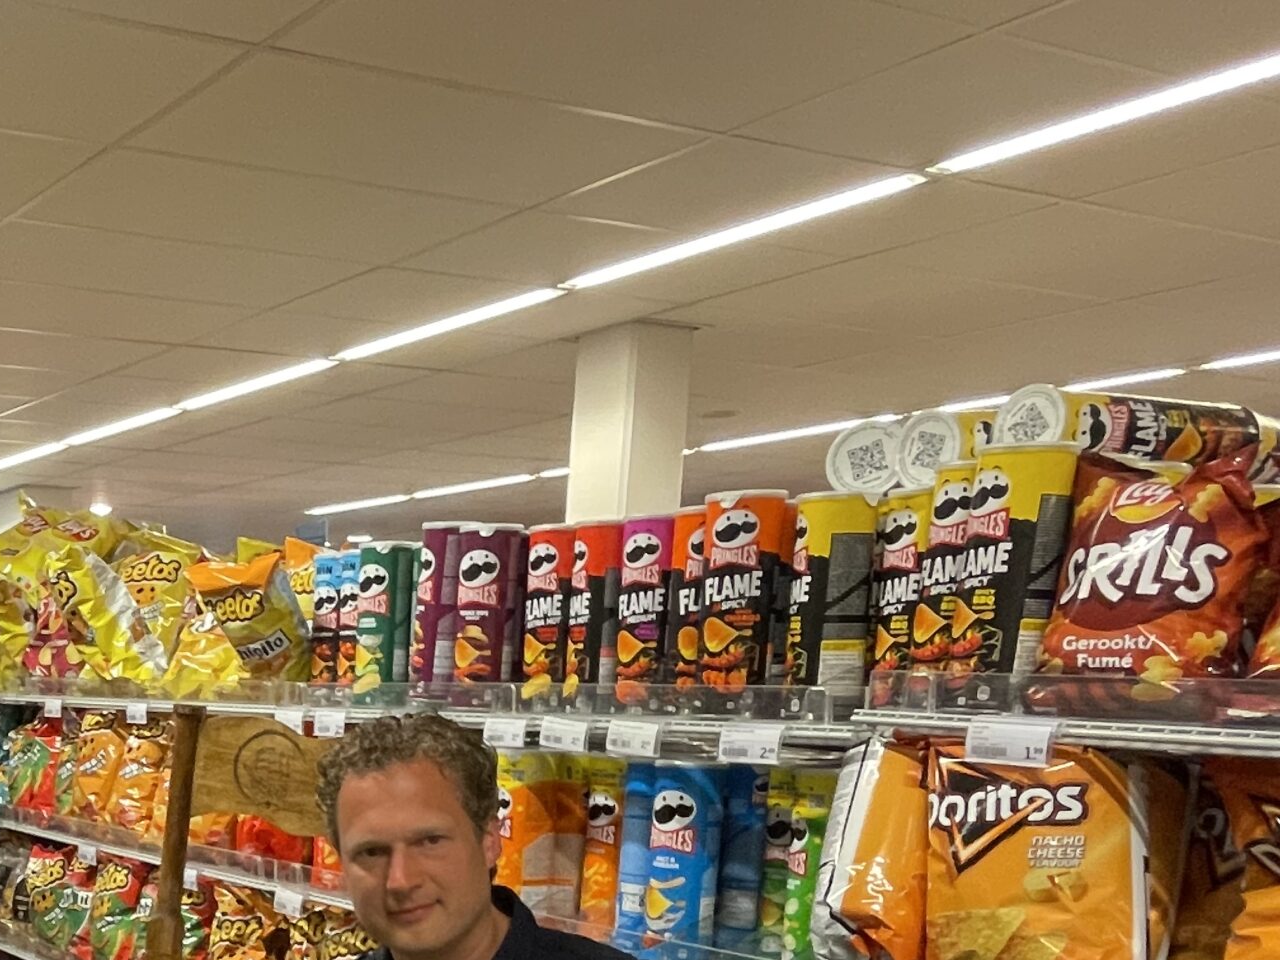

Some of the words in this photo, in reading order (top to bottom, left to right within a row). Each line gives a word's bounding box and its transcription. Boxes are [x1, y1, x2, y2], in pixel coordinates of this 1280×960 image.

[710, 544, 758, 570] PRINGLES
[705, 571, 763, 605] FLAME
[619, 589, 666, 620] FLAME
[1076, 651, 1133, 669] Fumé
[1031, 835, 1085, 846] NACHO
[1027, 847, 1084, 859] CHEESE
